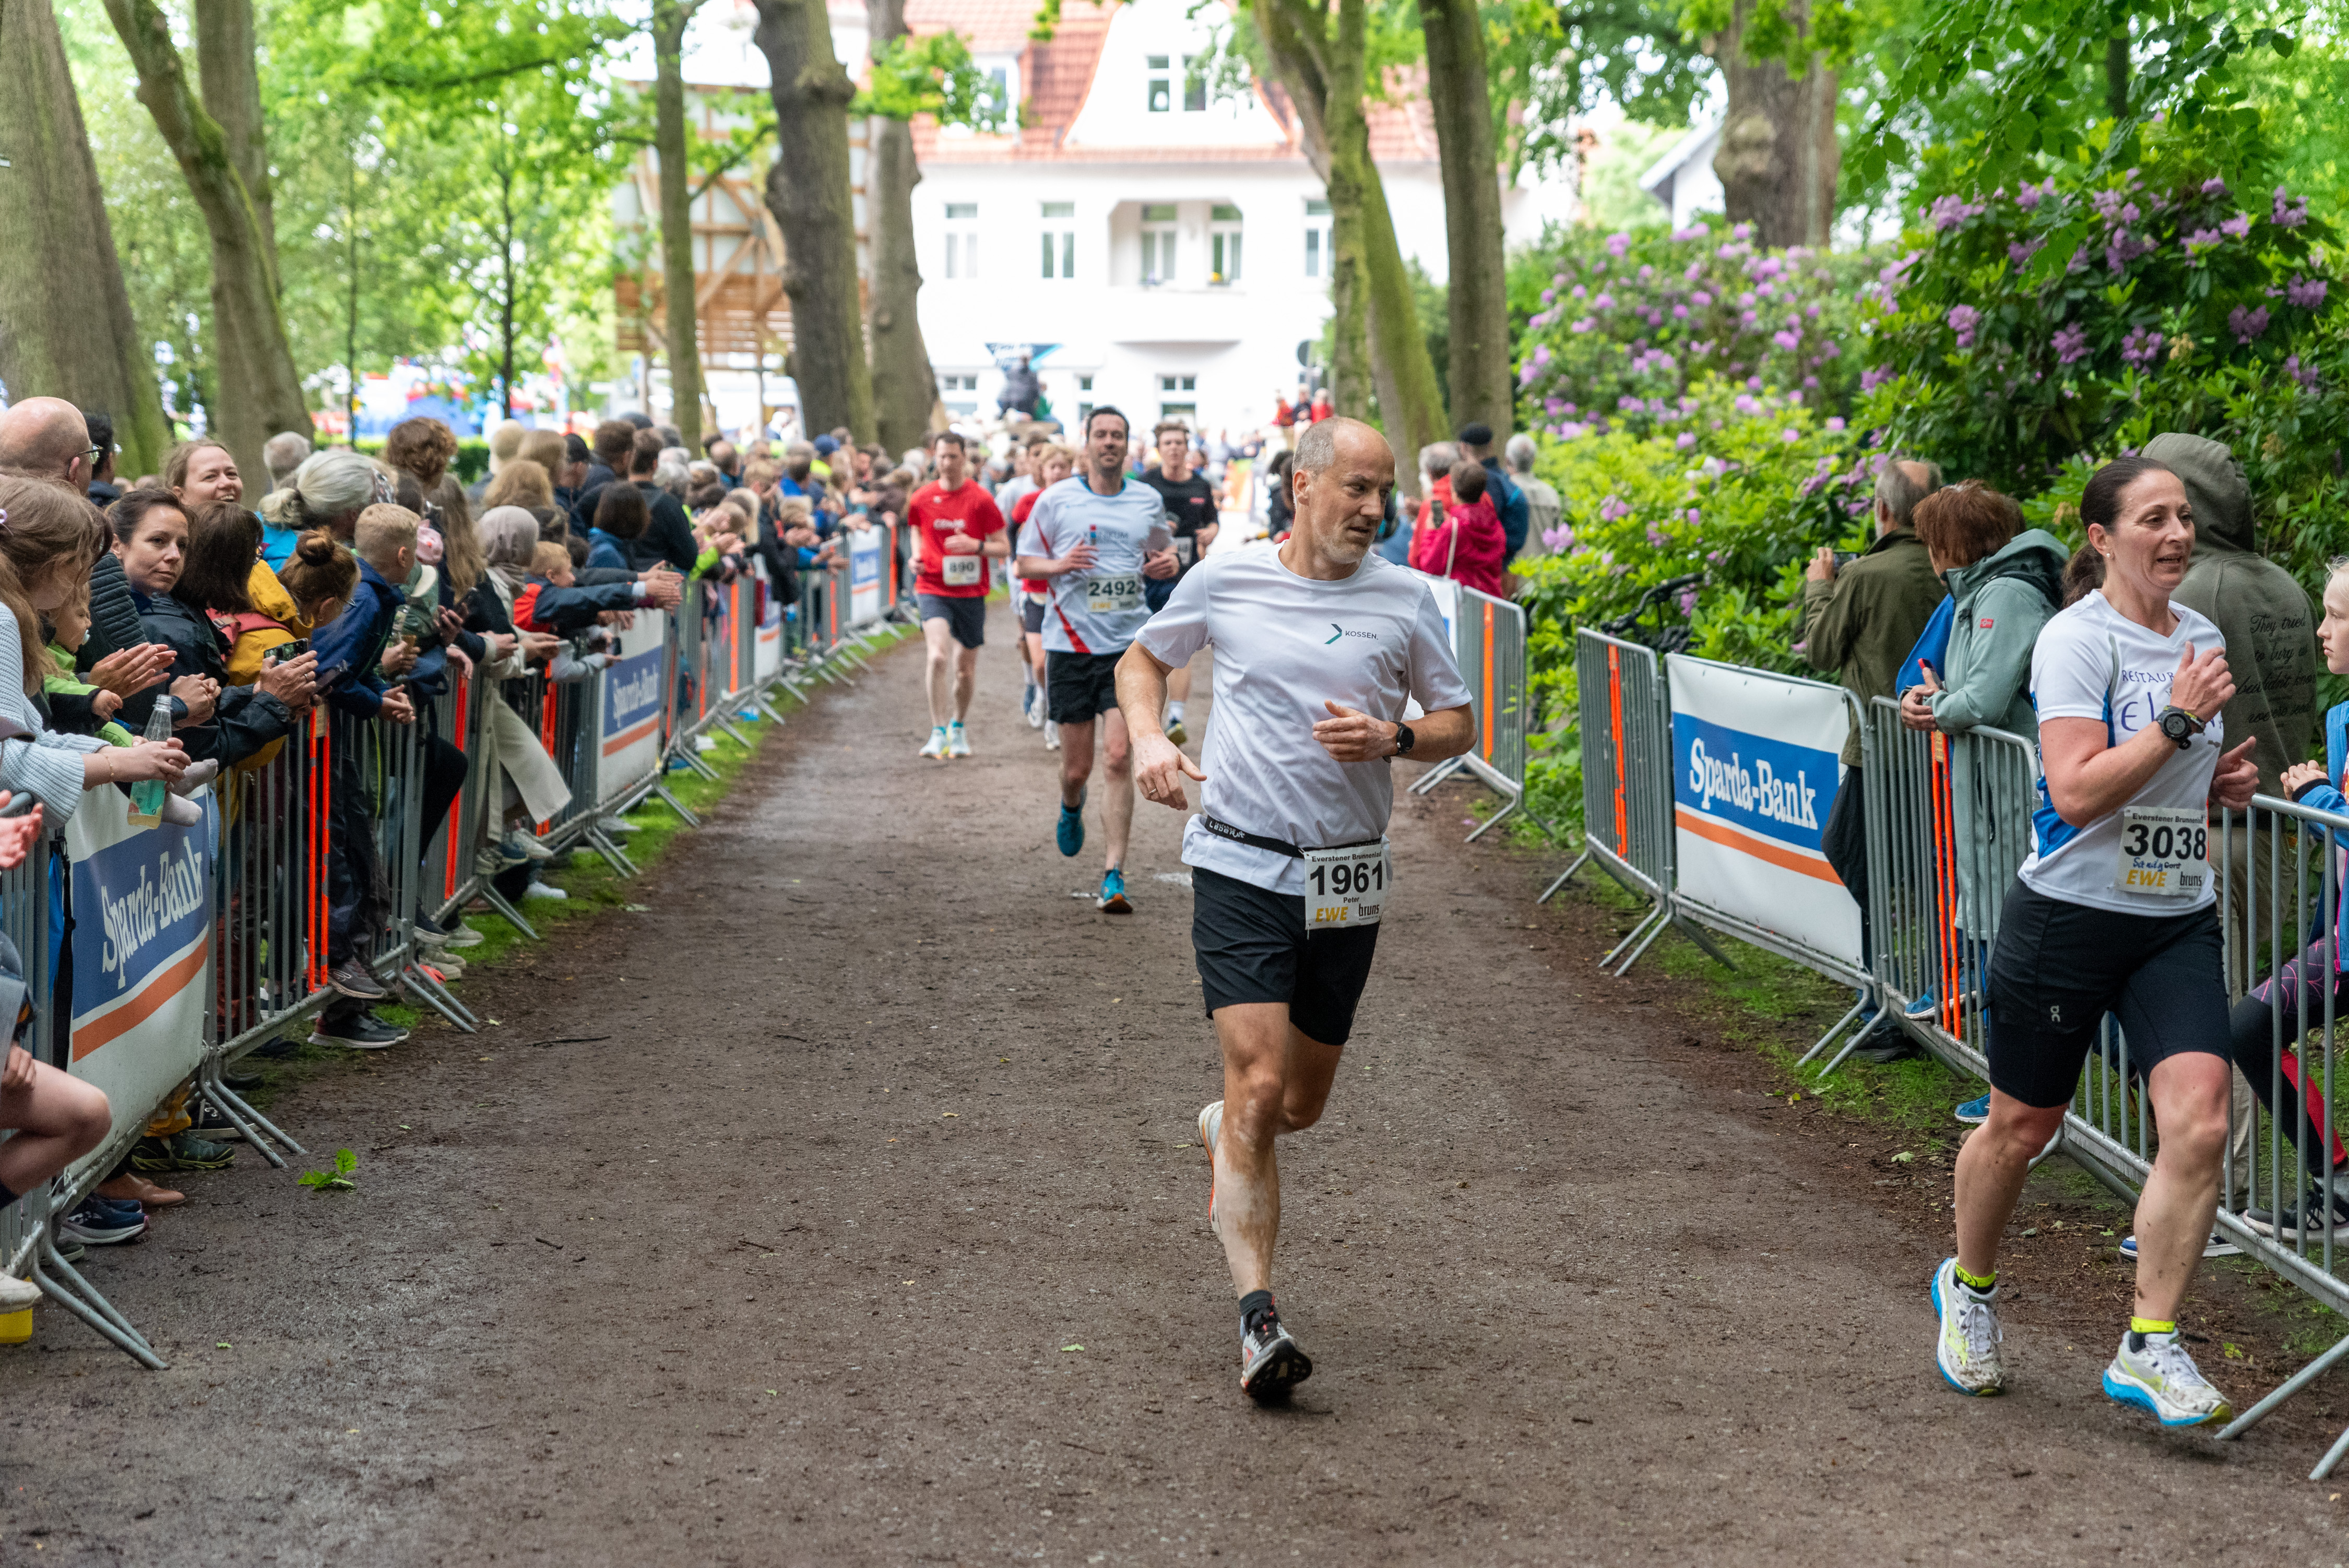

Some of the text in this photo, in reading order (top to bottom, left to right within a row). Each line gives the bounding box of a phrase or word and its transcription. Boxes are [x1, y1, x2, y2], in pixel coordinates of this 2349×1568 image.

[1089, 580, 1136, 596] 2492
[2122, 670, 2174, 683] RESTAUR
[1690, 737, 1818, 830] Sparda-Bank
[2132, 813, 2174, 822] Everstener
[2124, 824, 2206, 861] 3038
[1310, 860, 1382, 896] 1961
[2126, 869, 2202, 887] EWE bruns
[101, 836, 203, 990] Sparda-Bank
[1315, 903, 1380, 922] EWE bruns
